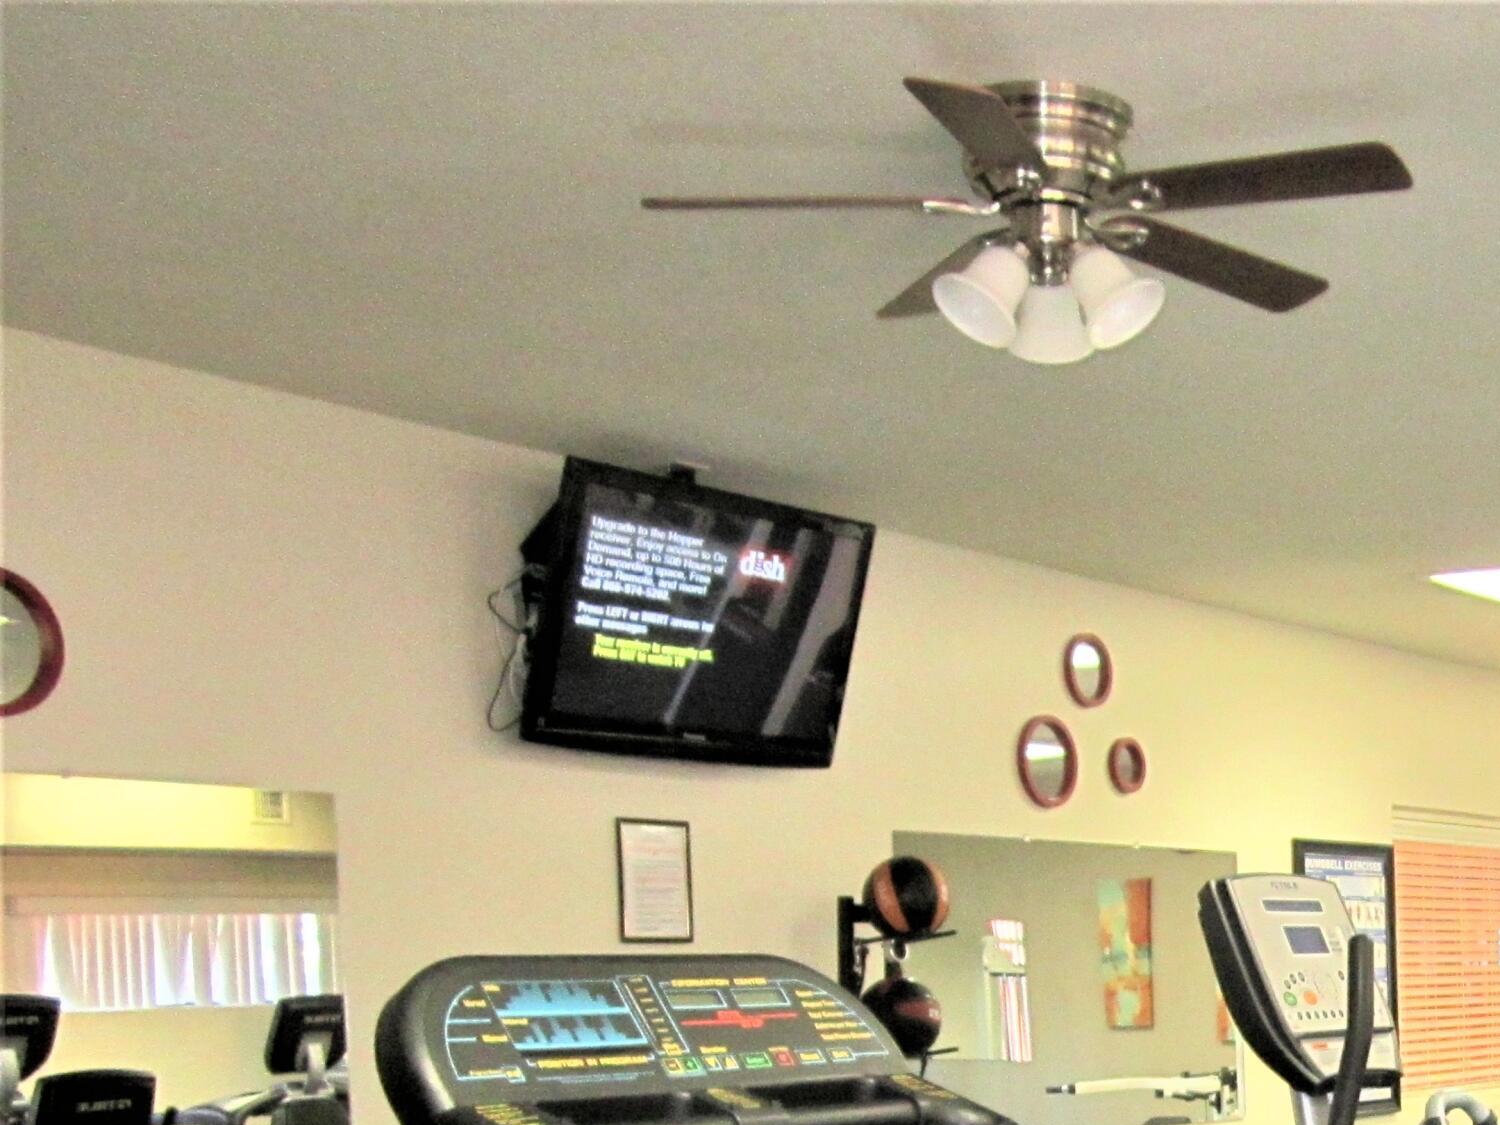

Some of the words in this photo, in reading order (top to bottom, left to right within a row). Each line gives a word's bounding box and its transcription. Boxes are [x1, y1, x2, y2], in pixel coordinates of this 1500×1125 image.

[592, 515, 636, 535] Upgrade
[638, 525, 649, 537] to
[650, 527, 666, 540] the
[668, 531, 705, 547] Hopper
[635, 552, 650, 562] up
[651, 552, 662, 563] to
[683, 558, 713, 573] Hours
[713, 565, 725, 575] of
[636, 536, 665, 553] Enjoy
[701, 551, 712, 561] to
[712, 551, 728, 564] On
[605, 557, 654, 576] recording
[689, 570, 712, 584] Free
[657, 577, 678, 590] and
